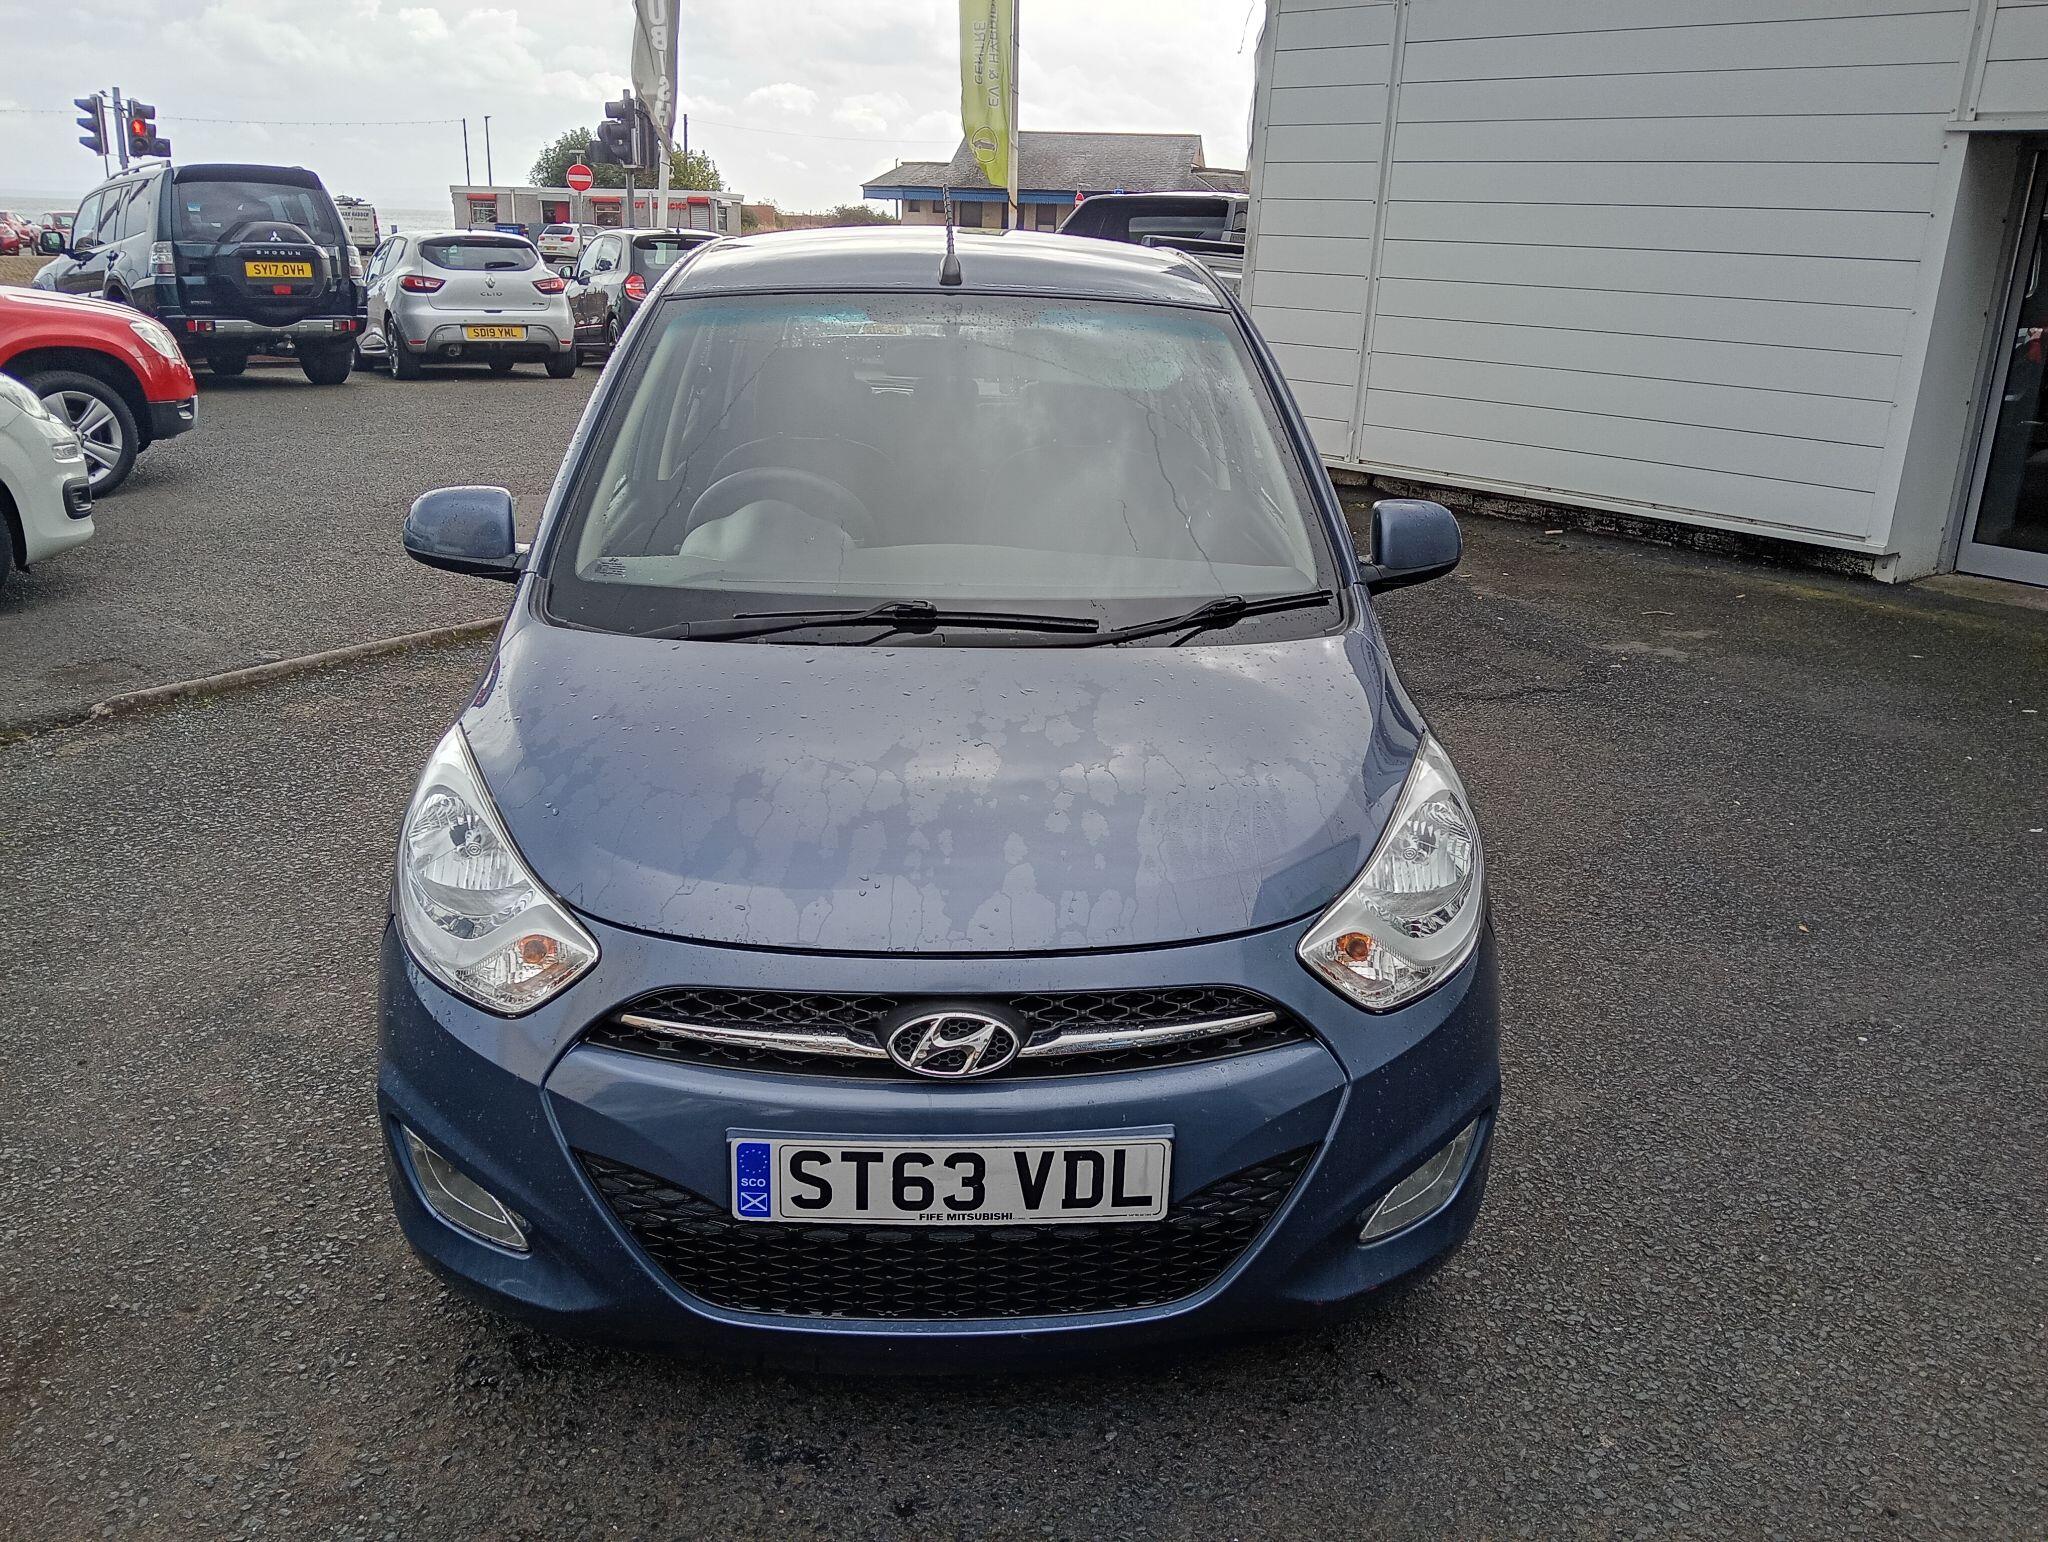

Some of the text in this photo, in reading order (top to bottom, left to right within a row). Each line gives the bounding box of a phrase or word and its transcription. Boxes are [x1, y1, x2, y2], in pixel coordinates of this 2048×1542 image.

[253, 264, 305, 275] SY17 OVH
[473, 328, 517, 338] SD19 YML
[740, 1178, 767, 1188] SCO
[789, 1149, 1153, 1212] ST63 VDL
[918, 1213, 944, 1221] FIFE
[946, 1212, 1014, 1221] MITSUBISHI
